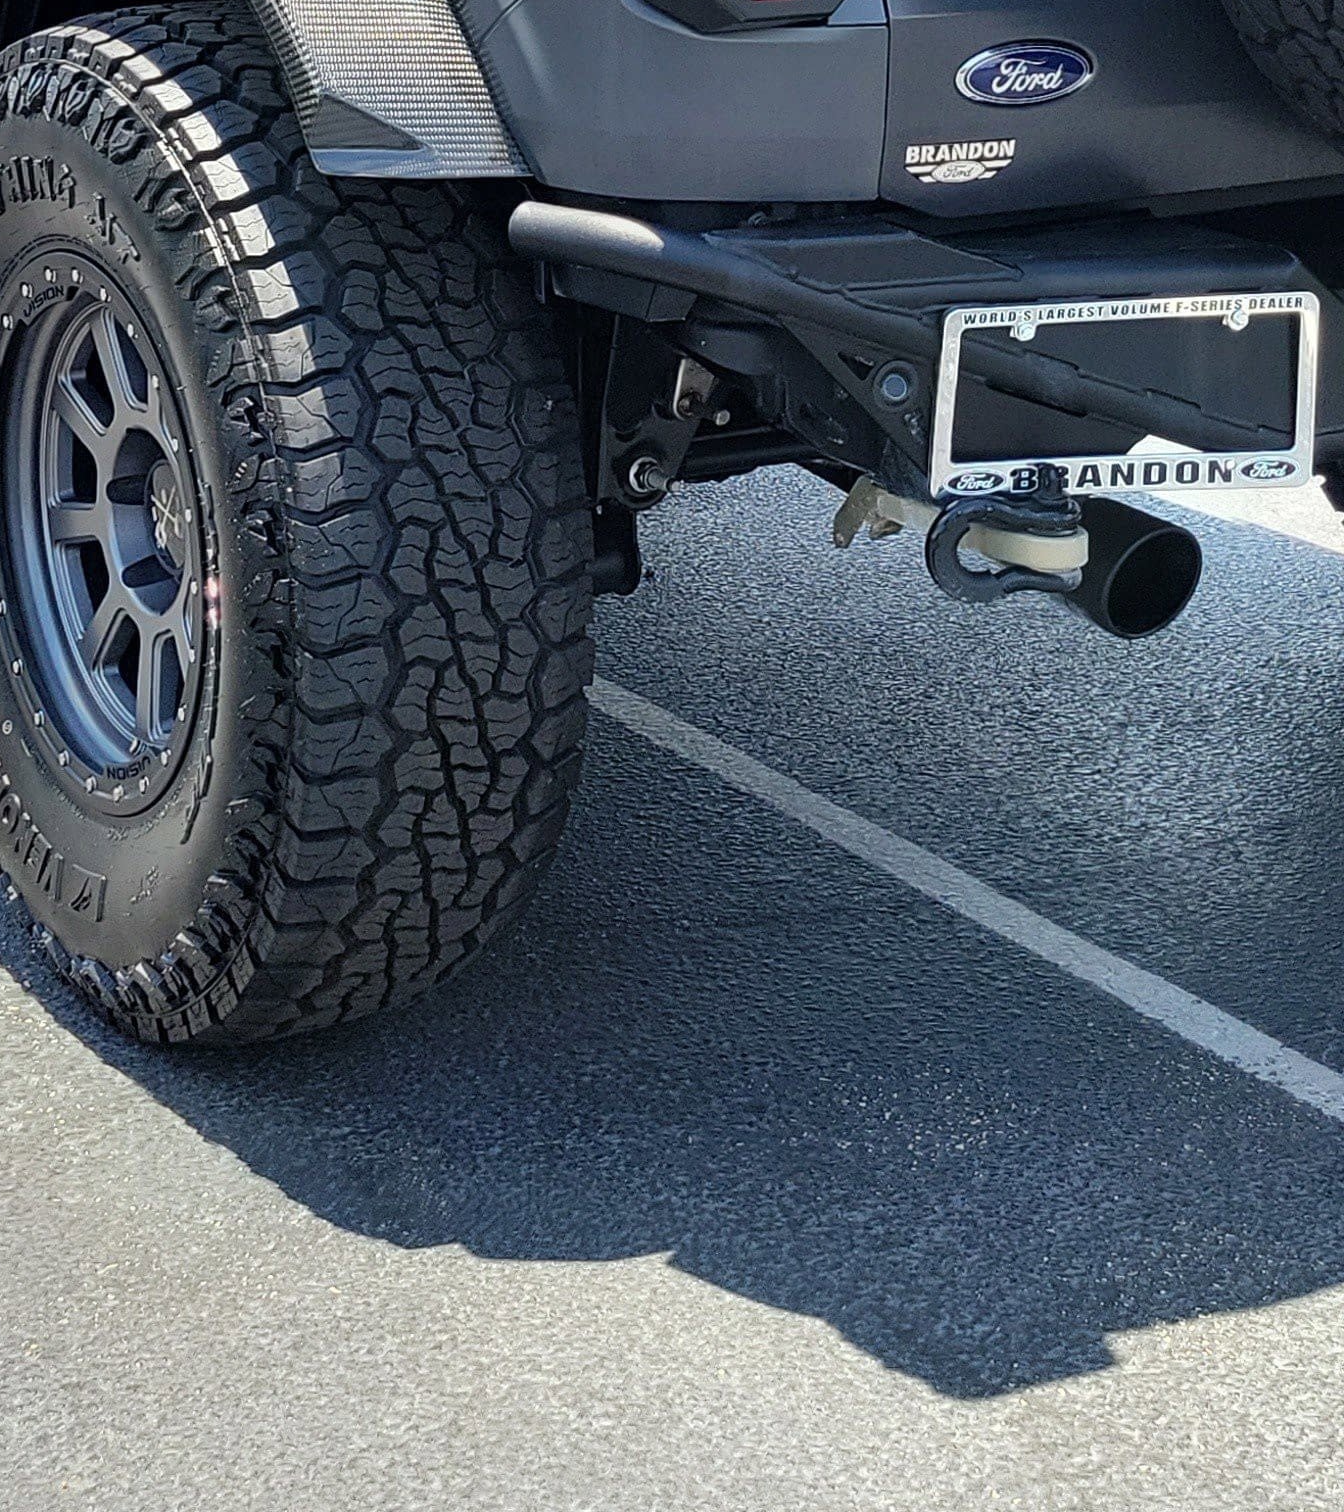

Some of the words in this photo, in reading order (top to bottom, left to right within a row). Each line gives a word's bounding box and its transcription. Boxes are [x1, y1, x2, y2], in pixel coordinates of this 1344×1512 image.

[991, 58, 1064, 95] Ford
[906, 139, 1016, 164] BRANDON
[942, 164, 977, 179] Ford
[22, 284, 64, 317] VISION
[963, 310, 1032, 325] WORLD'S
[1038, 306, 1105, 320] LARGEST
[1110, 301, 1170, 316] VOLUME
[1175, 299, 1243, 313] F-SERIES
[1248, 296, 1303, 310] DEALER
[956, 473, 995, 490] Ford
[1249, 460, 1288, 479] Ford
[106, 756, 151, 781] VISION
